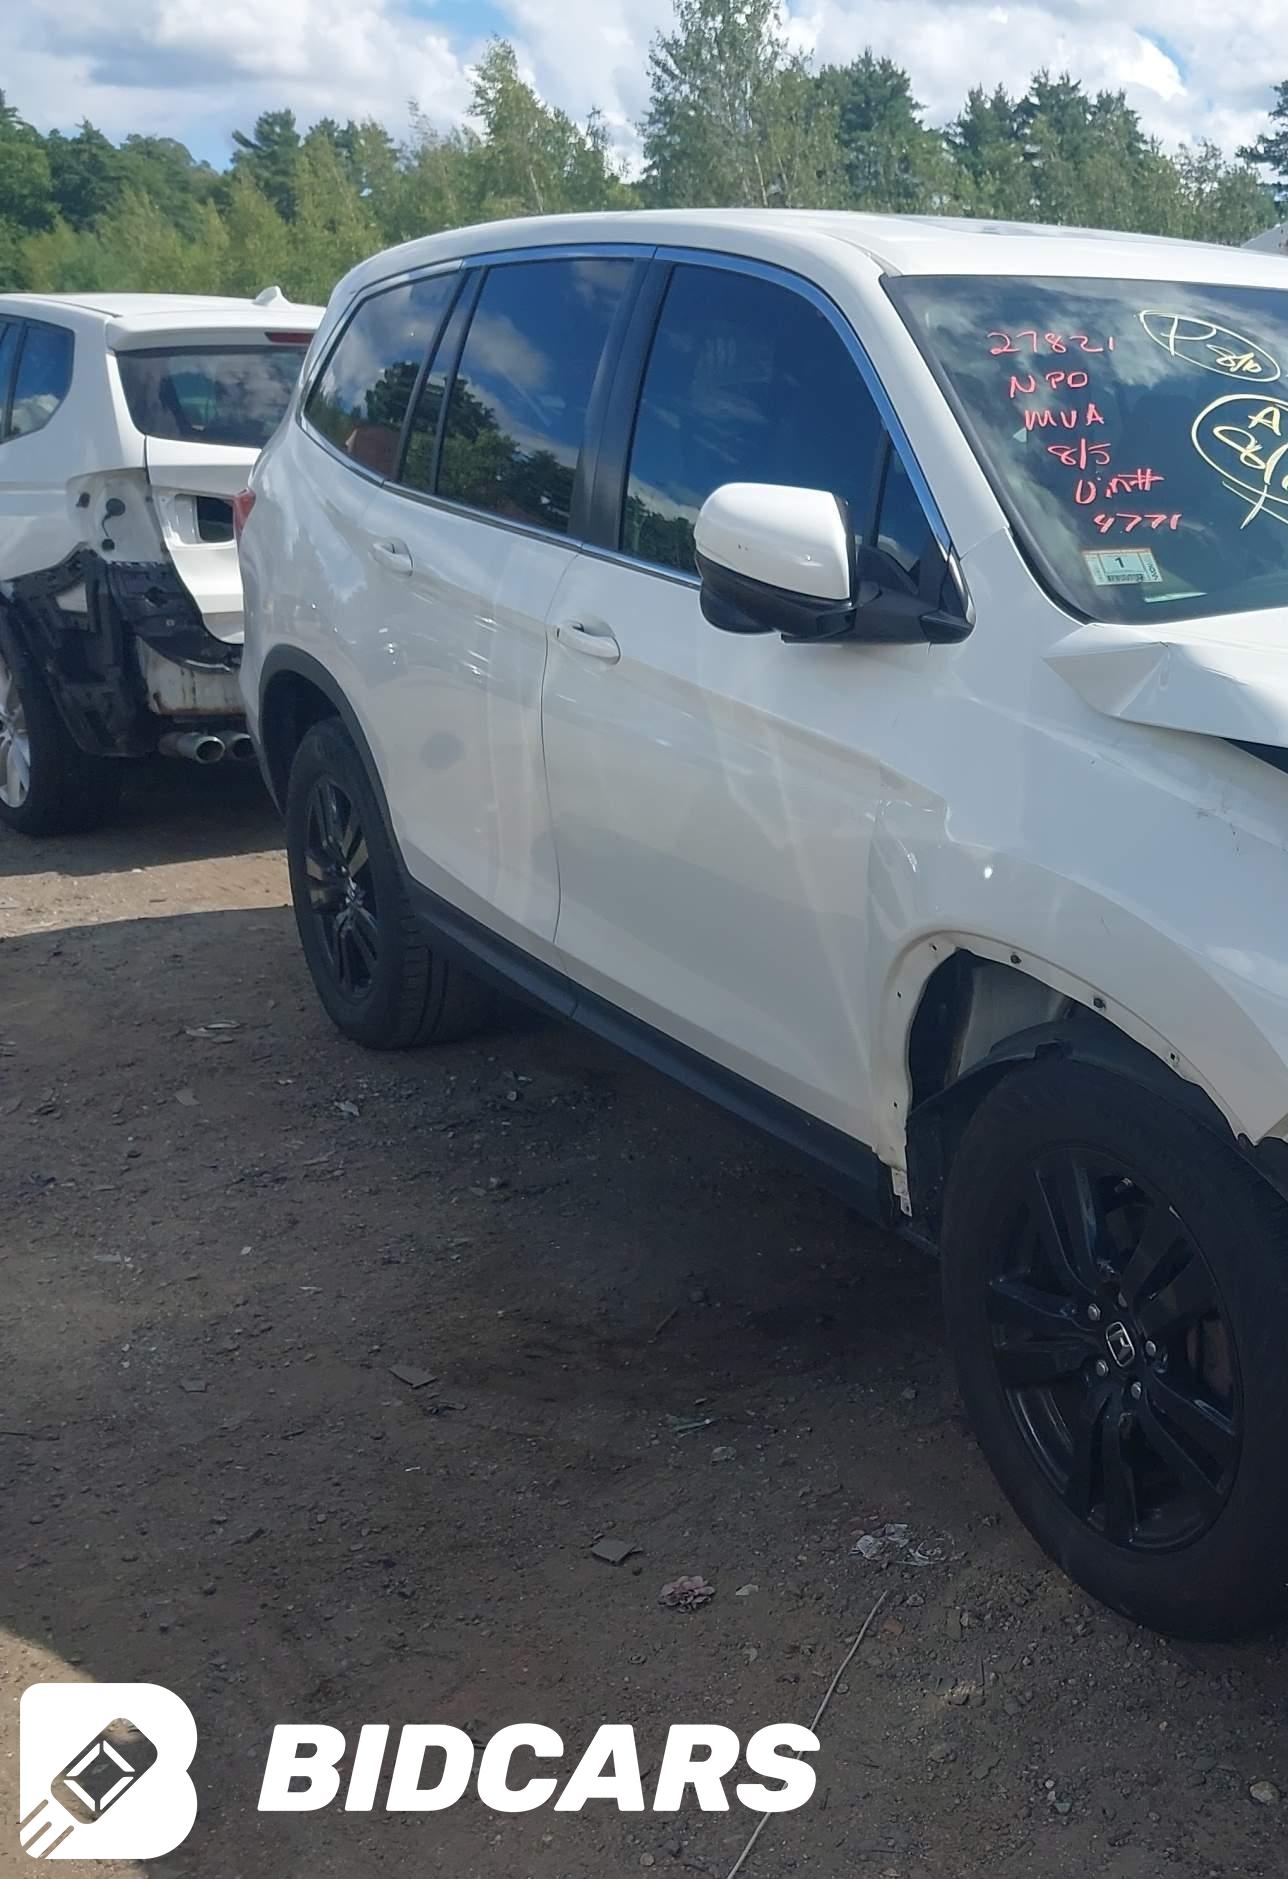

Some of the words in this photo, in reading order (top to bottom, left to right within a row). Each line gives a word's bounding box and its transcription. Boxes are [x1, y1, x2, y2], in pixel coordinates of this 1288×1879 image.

[986, 331, 1114, 355] 27821
[1248, 406, 1282, 436] A
[1114, 556, 1125, 569] 1
